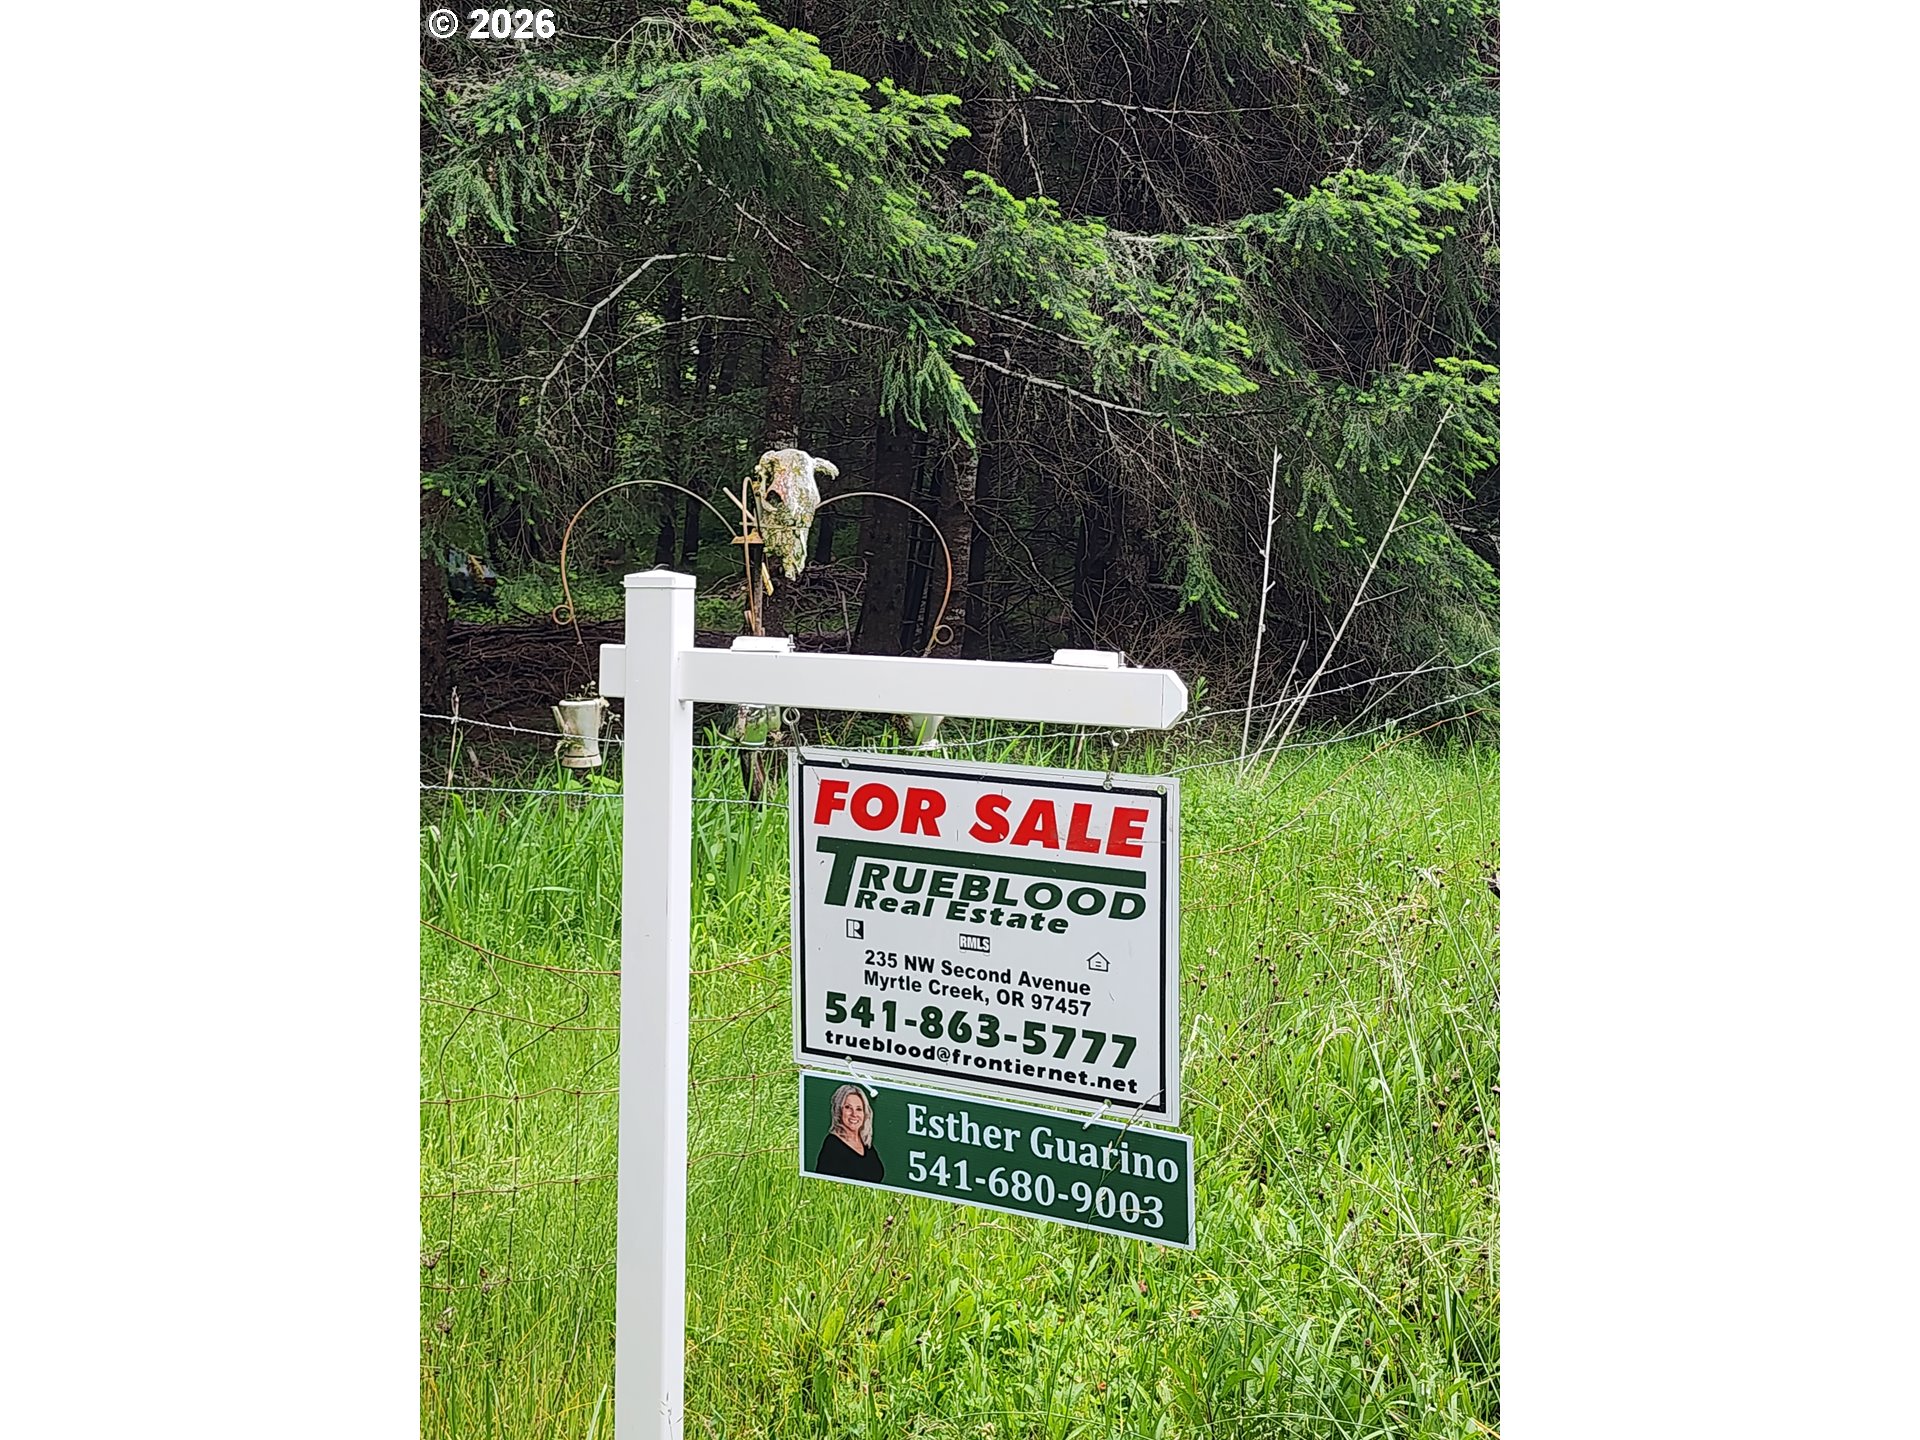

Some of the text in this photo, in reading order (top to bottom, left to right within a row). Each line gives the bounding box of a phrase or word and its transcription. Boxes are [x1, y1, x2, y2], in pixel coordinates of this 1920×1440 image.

[813, 778, 1150, 858] FOR SALE
[816, 836, 1147, 921] TRUEBLOOD
[854, 889, 1070, 935] Real Estate
[864, 949, 1091, 996] 235 NW Second Avenue
[960, 935, 990, 952] RMLS
[864, 969, 1092, 1017] Myrtle Creek, OR 97457
[825, 991, 1137, 1070] 541-863-5777
[825, 1029, 1138, 1094] trueblood@frontiernet.net
[907, 1104, 1180, 1184] Esther Guarino
[908, 1151, 1164, 1229] 541-680-9003
